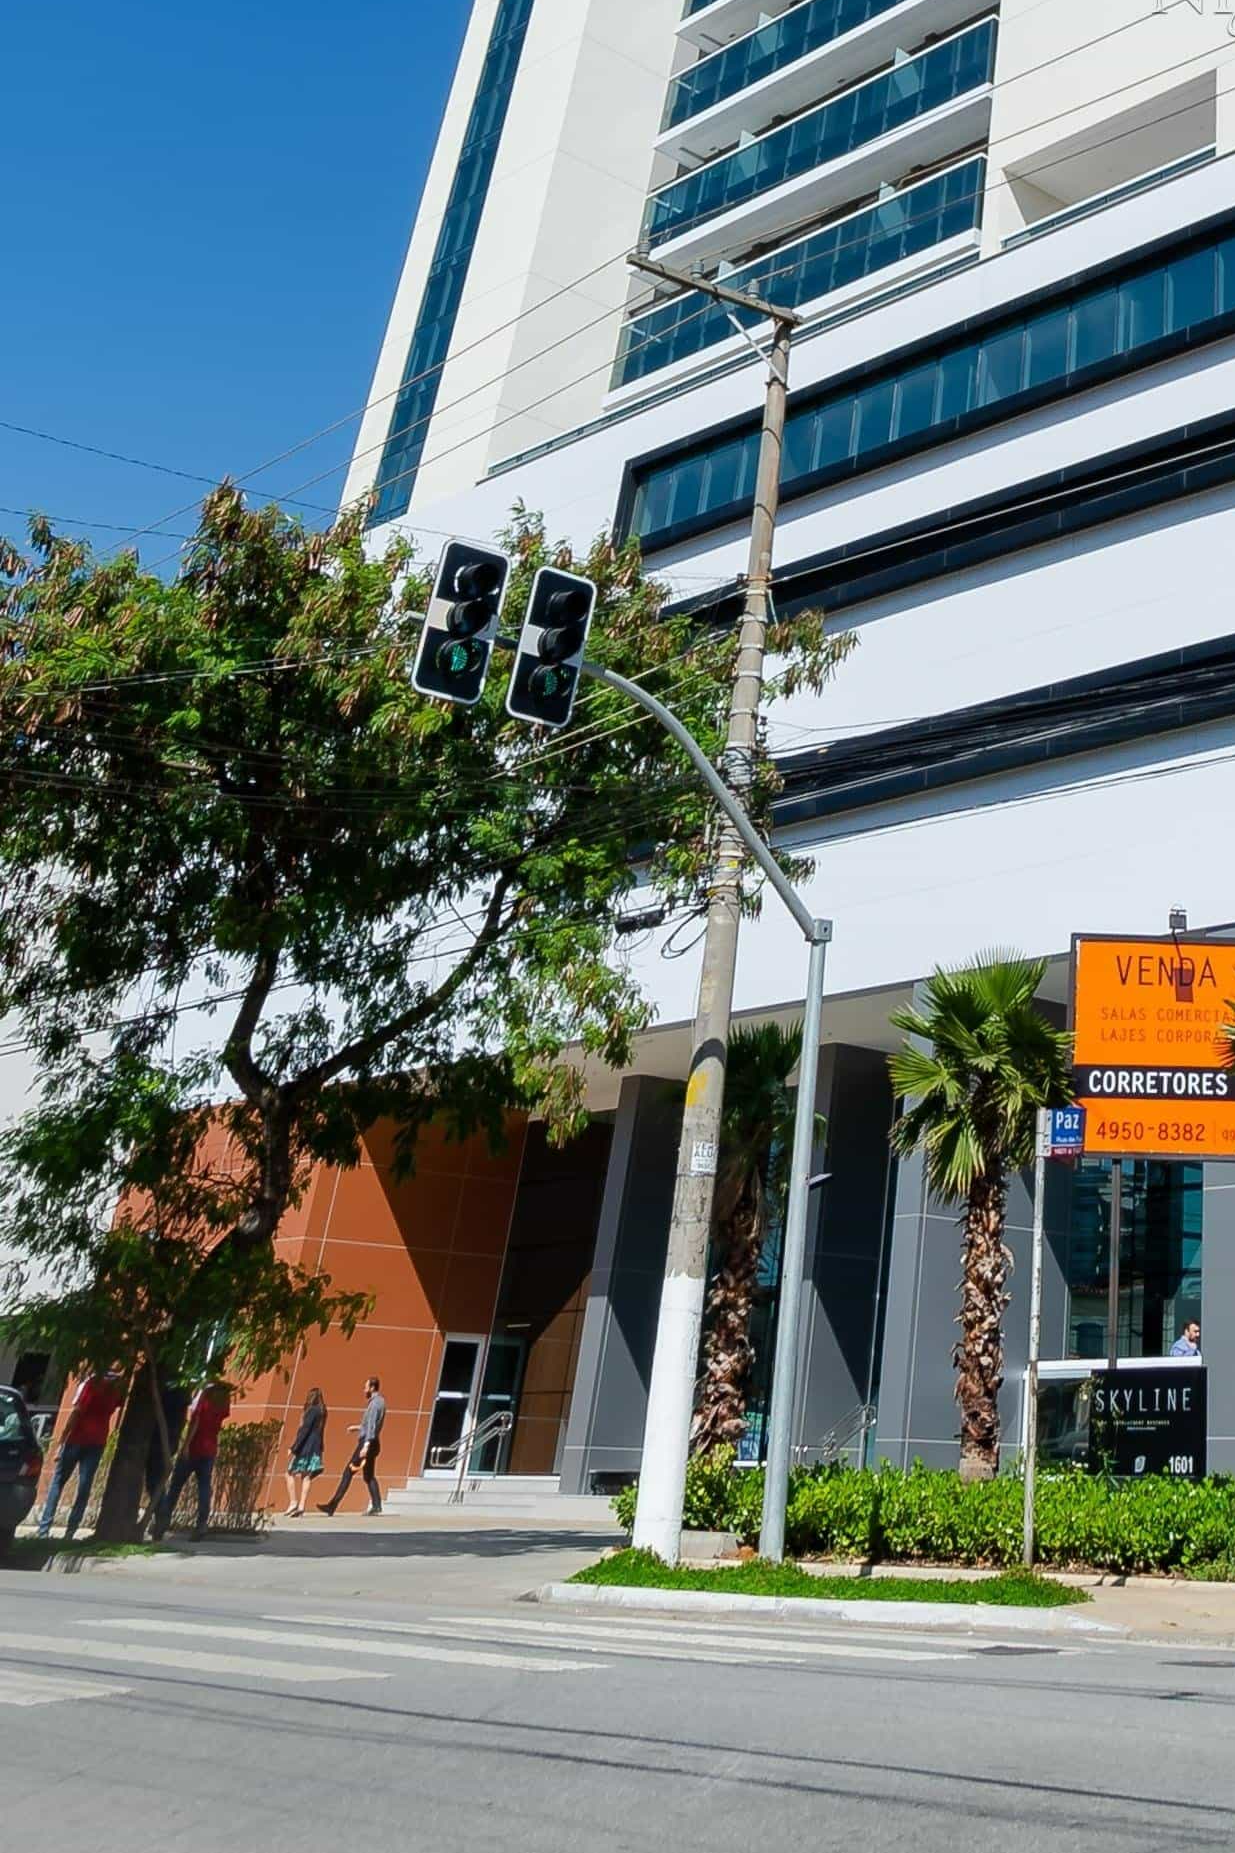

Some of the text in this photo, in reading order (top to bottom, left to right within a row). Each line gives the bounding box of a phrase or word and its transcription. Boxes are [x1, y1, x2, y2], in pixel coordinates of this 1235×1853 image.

[1116, 955, 1217, 988] VENDA
[1101, 1007, 1147, 1021] SALAS
[1101, 1027, 1147, 1042] LAJES
[1088, 1070, 1228, 1096] CORRETORES
[1056, 1111, 1079, 1129] Paz
[1096, 1121, 1206, 1142] 4950-8382
[1095, 1387, 1192, 1413] SKYLINE
[1168, 1455, 1194, 1474] 1601
